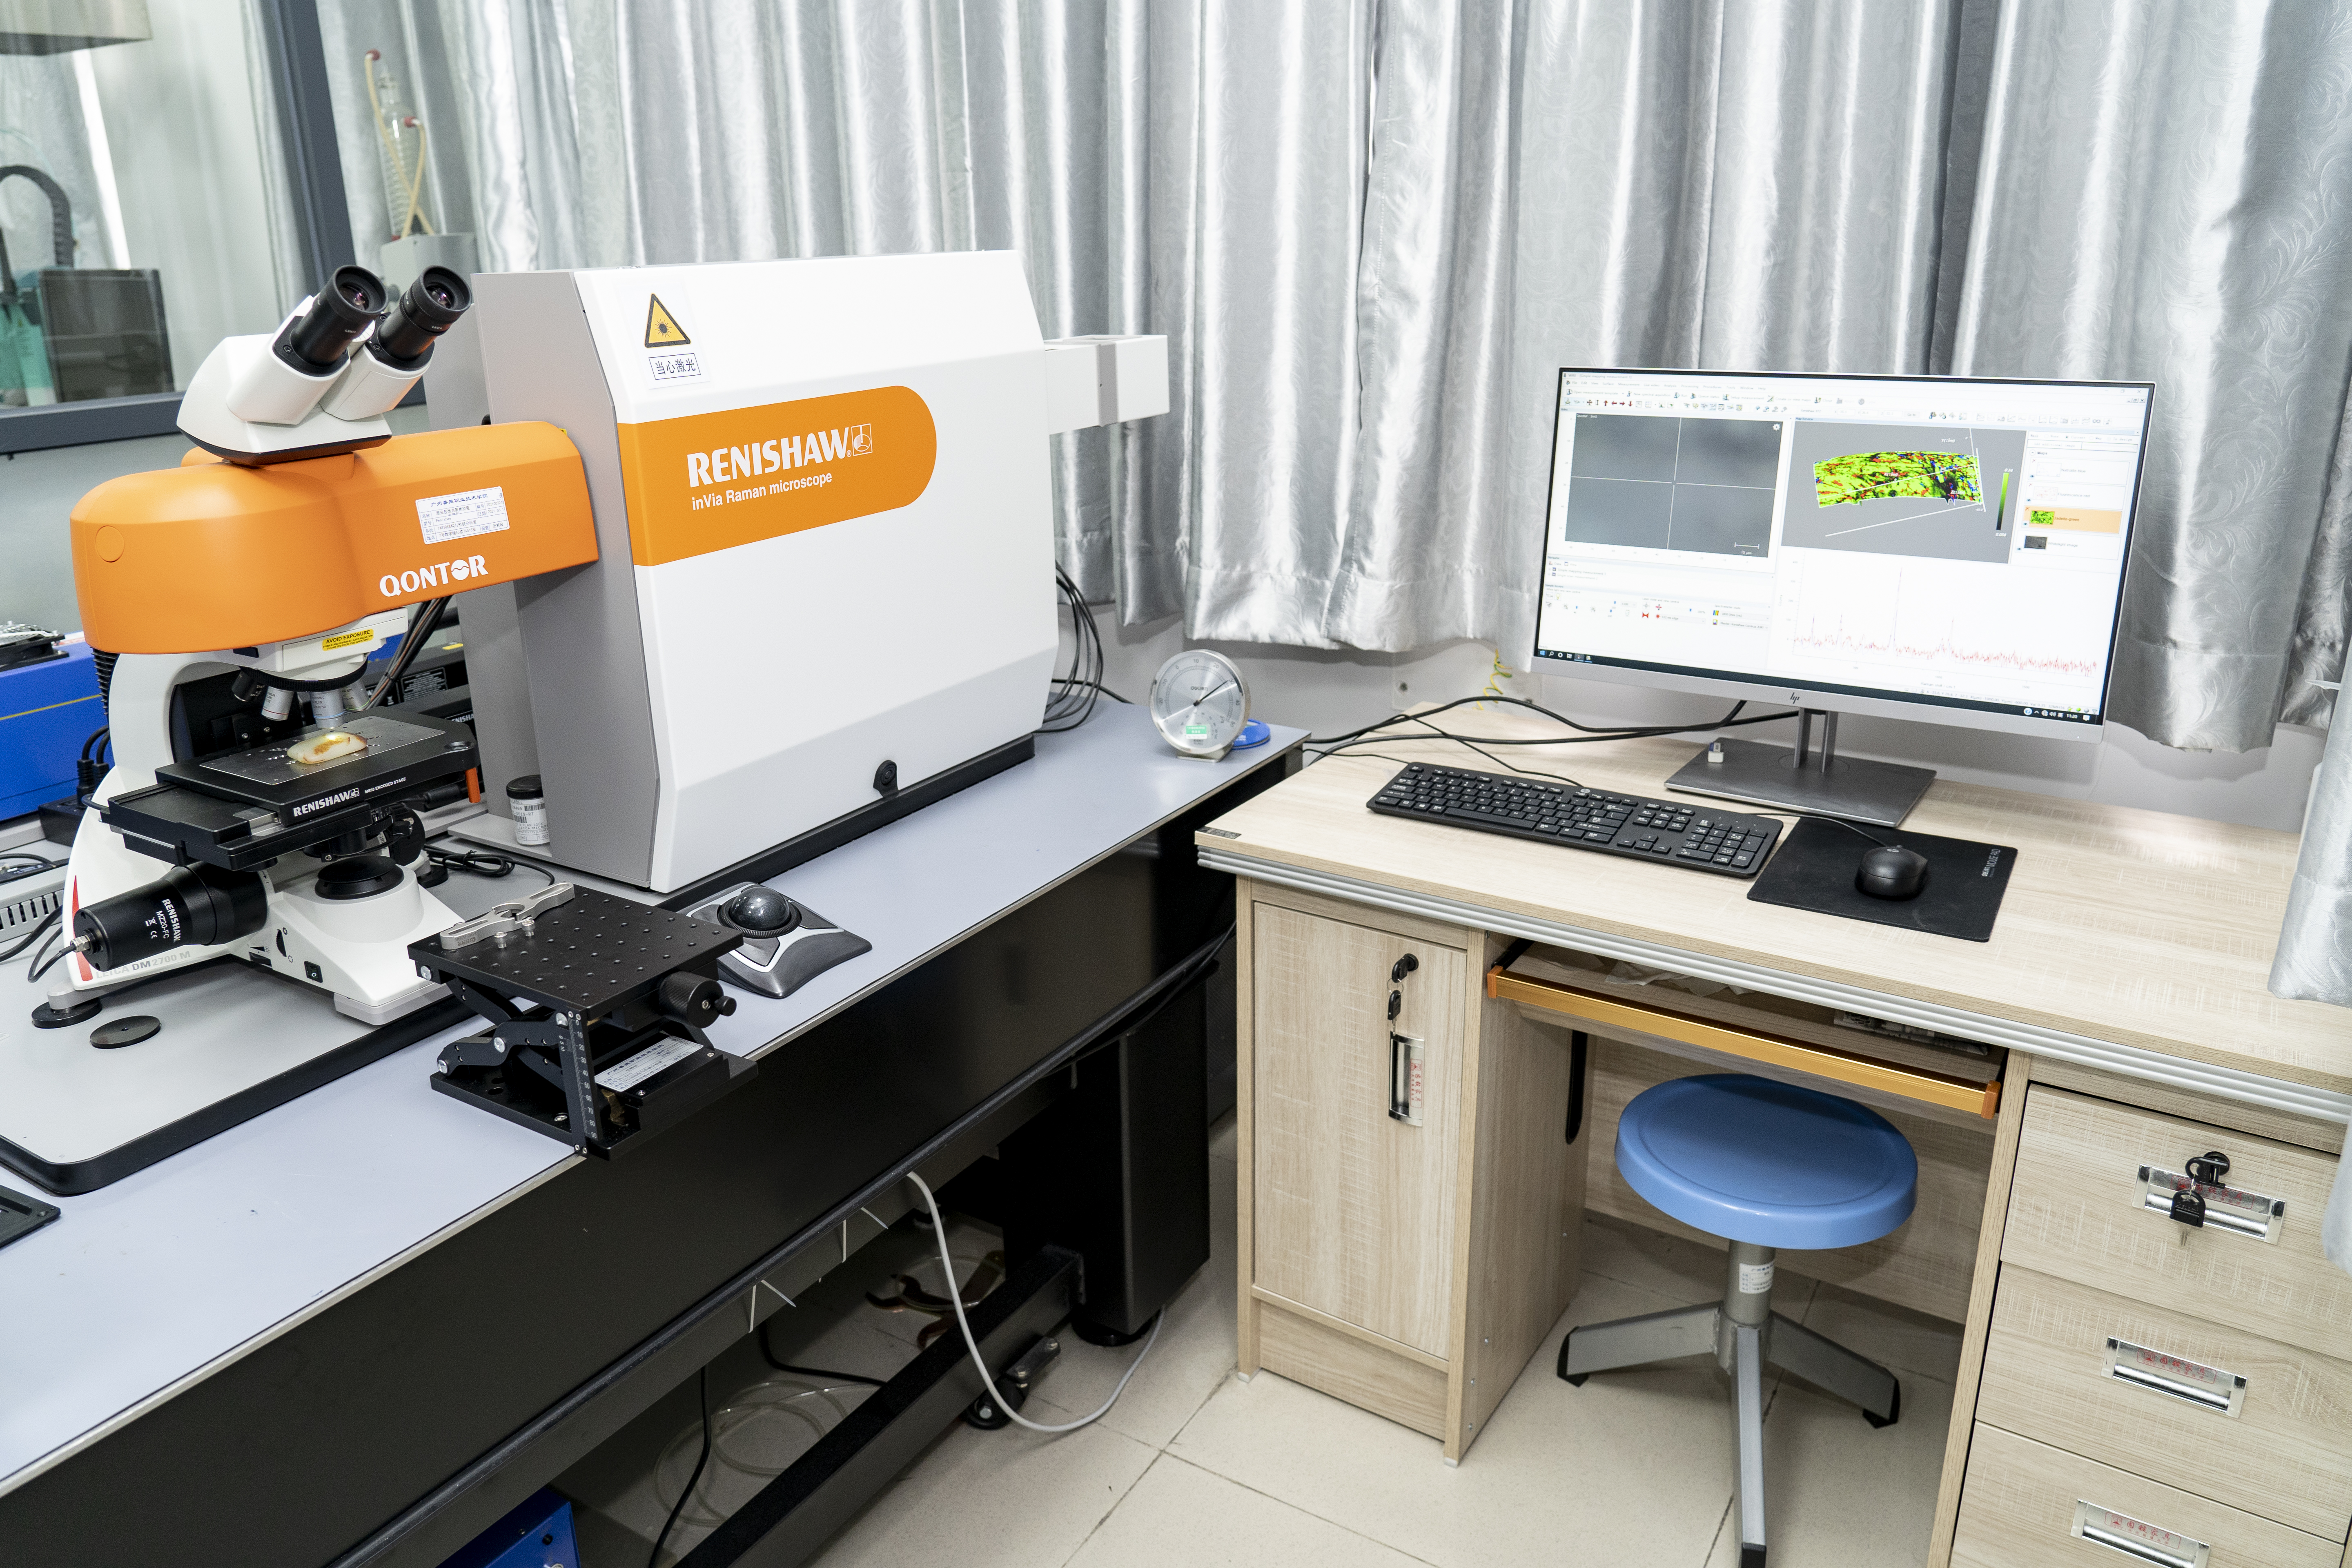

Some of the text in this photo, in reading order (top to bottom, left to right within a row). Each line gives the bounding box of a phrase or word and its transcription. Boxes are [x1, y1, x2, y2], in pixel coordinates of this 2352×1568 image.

[655, 358, 696, 375] 当心激光
[687, 427, 849, 487] RENISHAW
[692, 472, 832, 510] inVia Raman microscope
[379, 555, 489, 597] QONTOR
[343, 630, 370, 640] EXPOSURE
[293, 790, 351, 817] RENISHAW
[375, 781, 393, 790] ENCODED
[156, 910, 169, 939] MZ20-FC
[162, 898, 181, 942] RENISHAW
[179, 951, 191, 960] M
